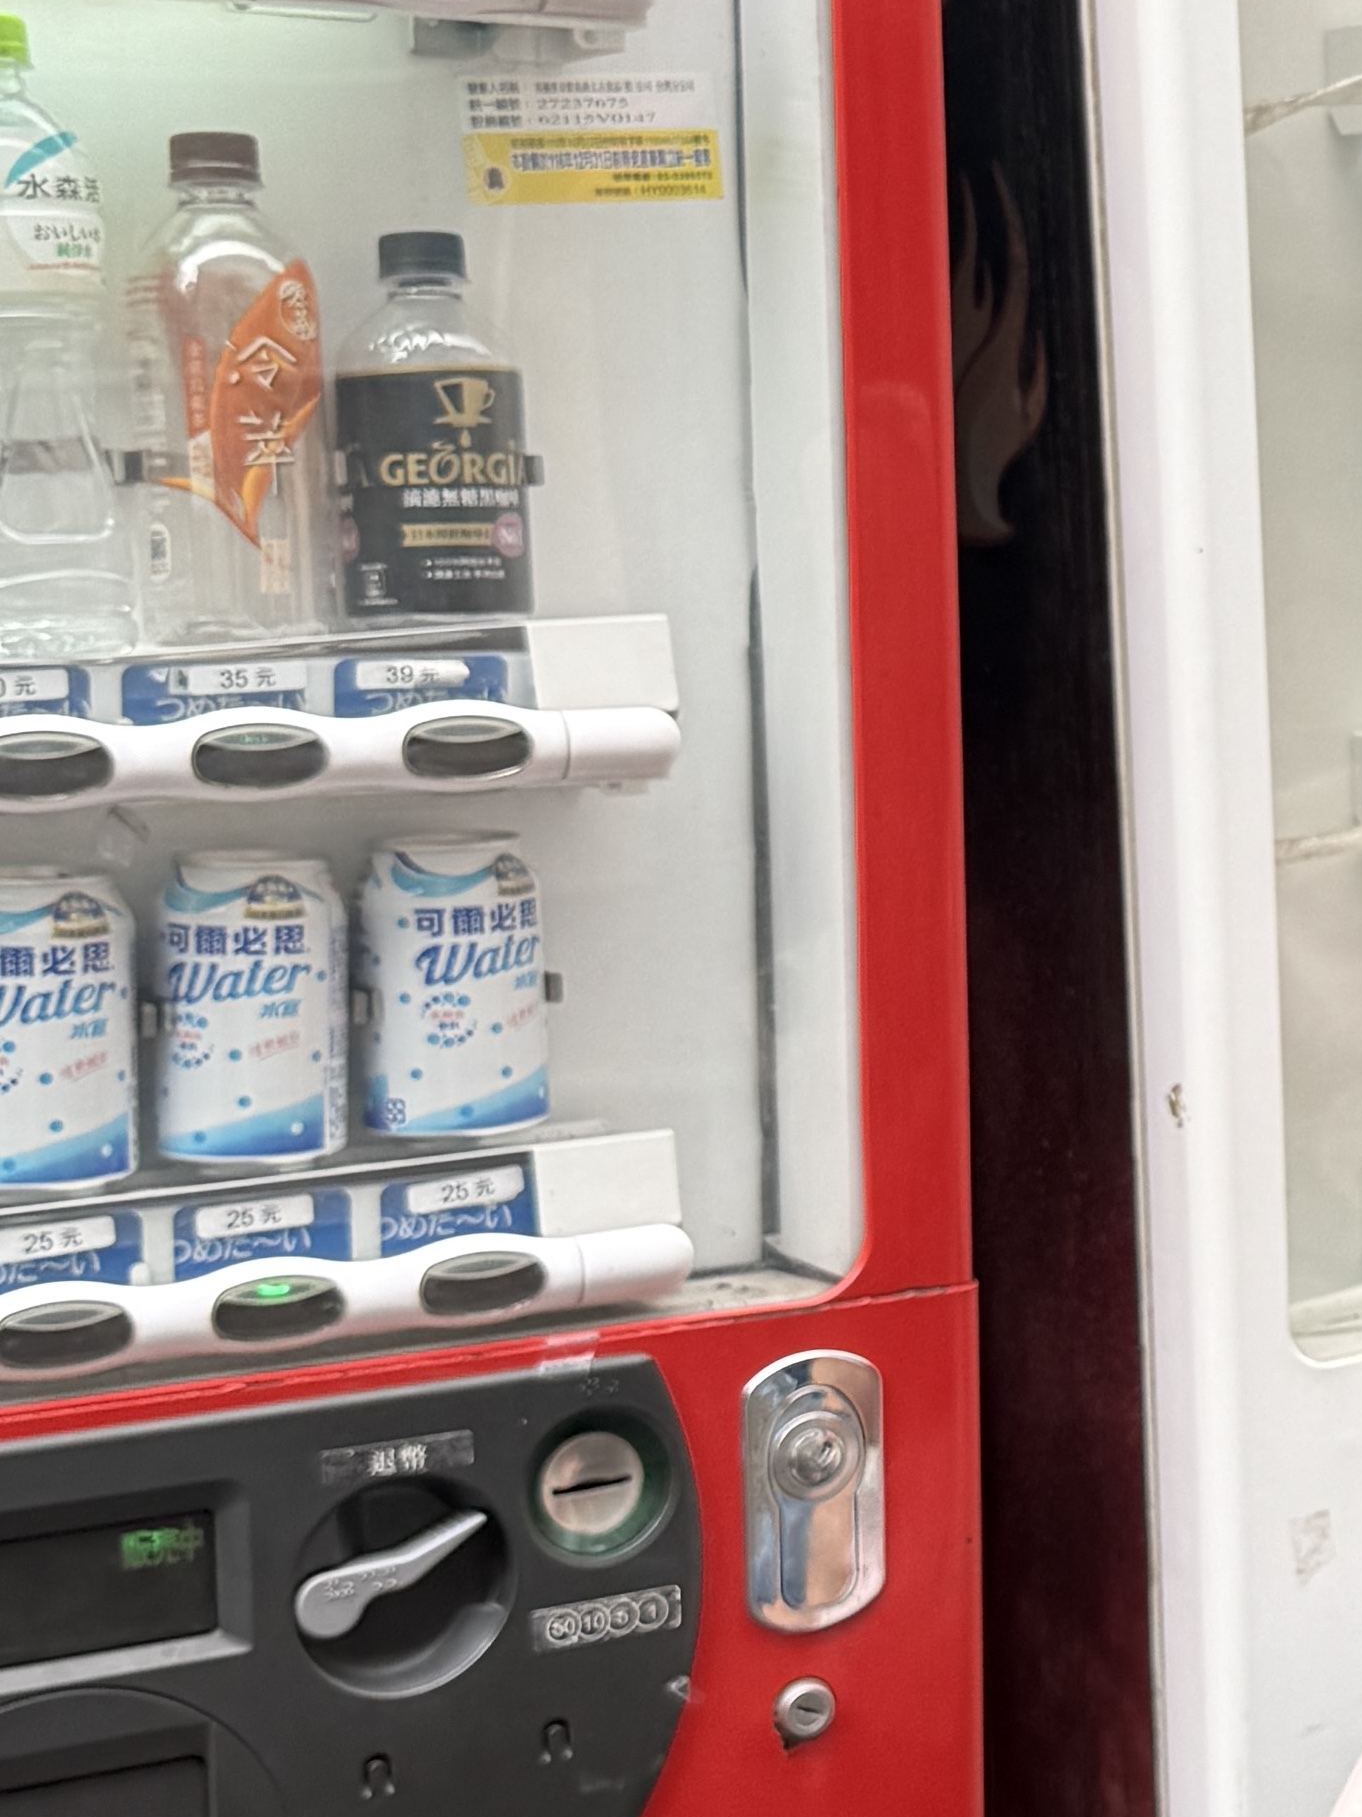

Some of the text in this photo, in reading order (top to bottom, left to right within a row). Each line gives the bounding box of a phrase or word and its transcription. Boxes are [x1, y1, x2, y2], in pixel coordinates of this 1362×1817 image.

[219, 666, 276, 689] 35 元
[386, 666, 441, 685] 39 元
[413, 897, 537, 938] 可爾必思
[165, 922, 307, 956] 可爾必思
[414, 934, 540, 986] Water
[168, 959, 312, 1006] Water
[441, 1176, 497, 1202] 25 元
[227, 1204, 282, 1230] 25 元
[23, 1228, 82, 1255] 25 元
